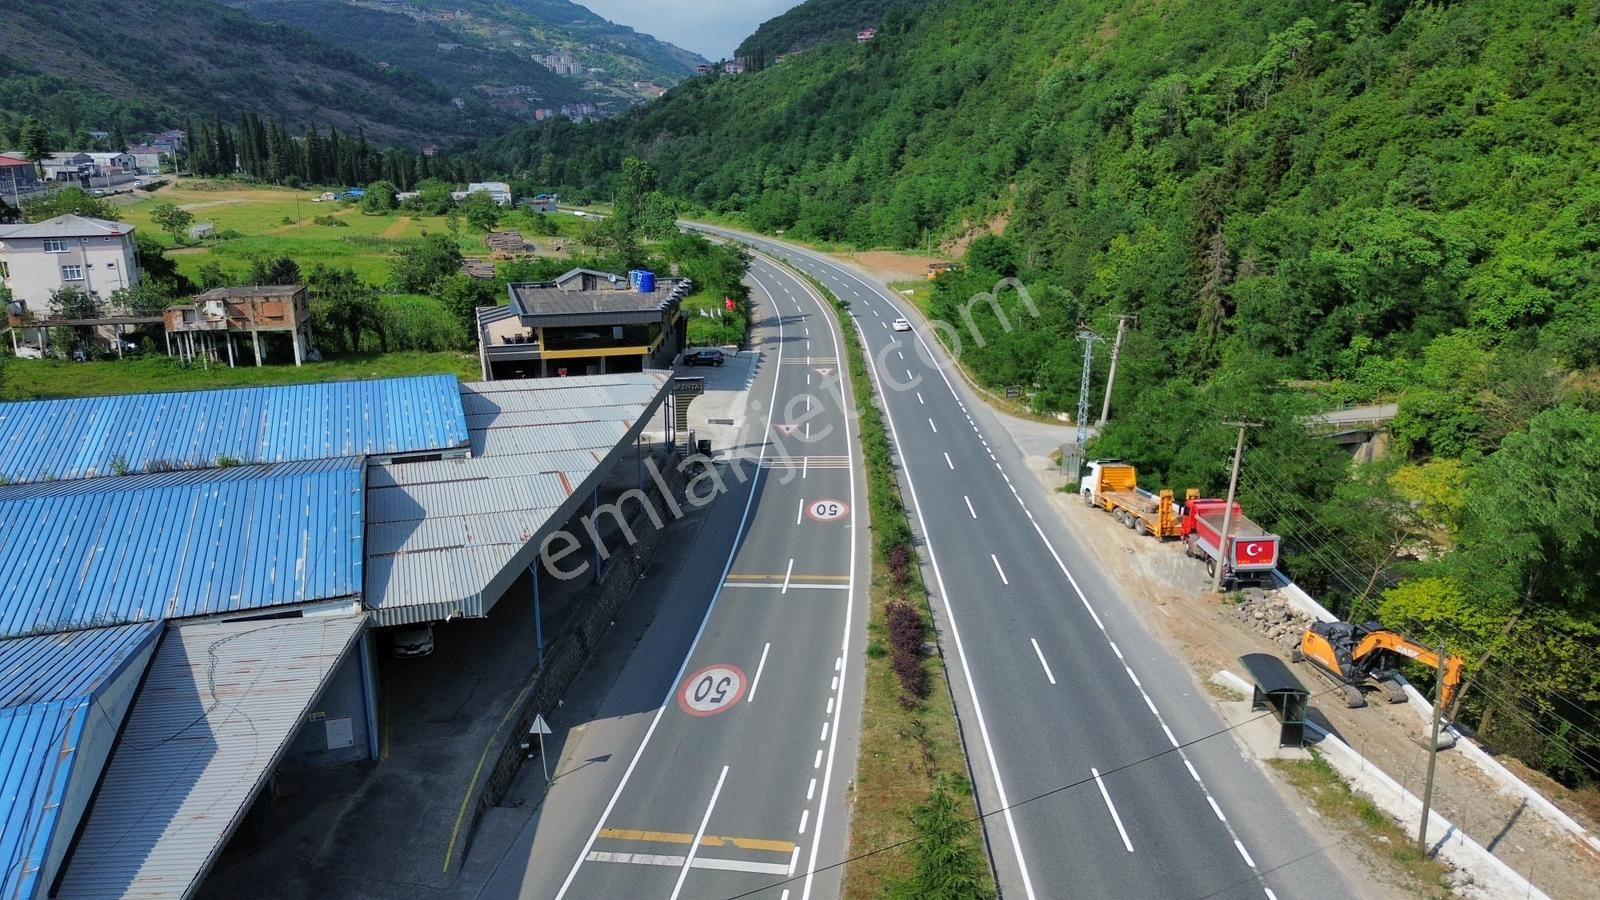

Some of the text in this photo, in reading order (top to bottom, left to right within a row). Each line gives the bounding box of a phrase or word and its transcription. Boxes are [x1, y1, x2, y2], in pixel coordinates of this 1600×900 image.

[816, 503, 838, 516] 50
[1395, 645, 1420, 659] CASE
[694, 675, 731, 704] 50
